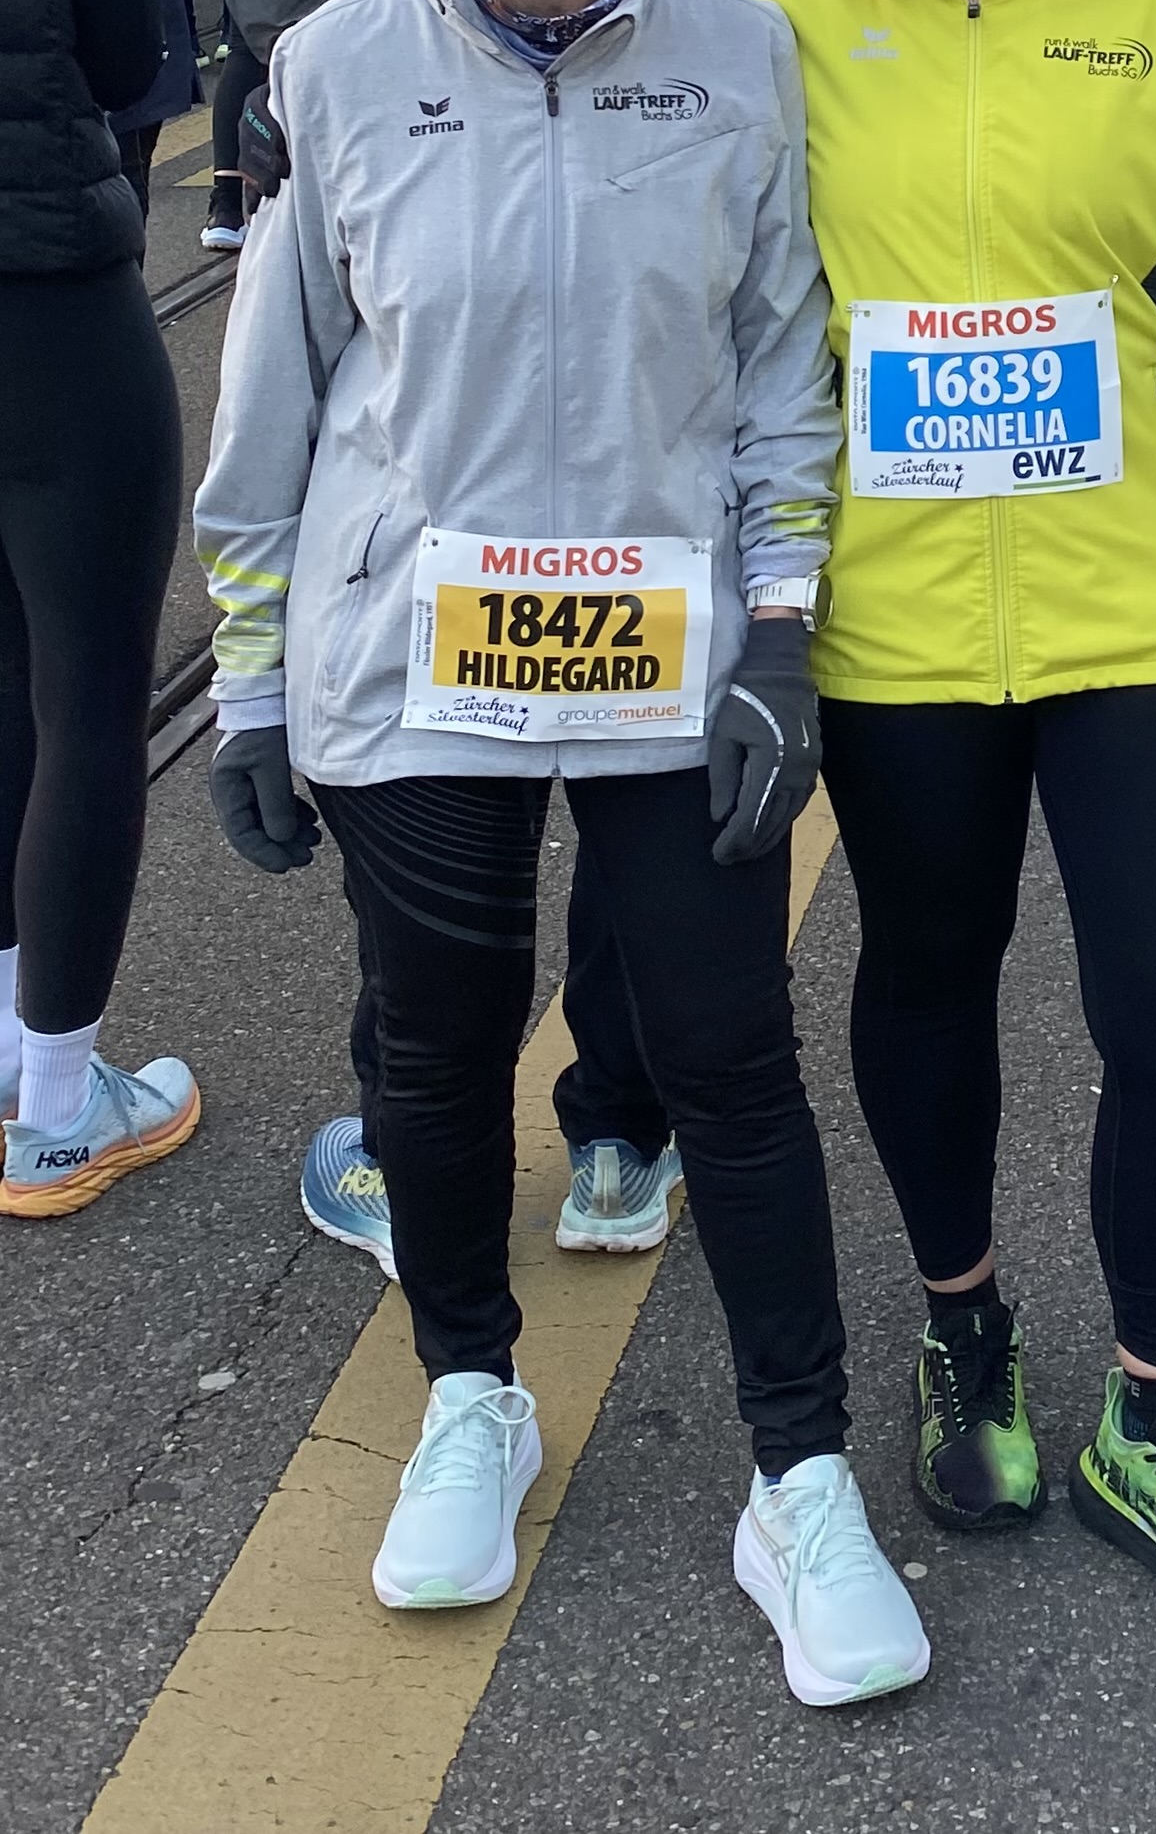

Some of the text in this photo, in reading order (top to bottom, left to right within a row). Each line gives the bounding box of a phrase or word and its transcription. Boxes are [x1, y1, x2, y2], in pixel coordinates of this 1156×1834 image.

[1044, 38, 1061, 46] run
[1072, 38, 1098, 50] walk
[1043, 46, 1136, 66] LAUF-TREFF
[1087, 63, 1138, 80] Buchs SG
[592, 86, 611, 95] run
[621, 82, 647, 95] walk
[593, 94, 686, 110] LAUF-TREFF
[641, 108, 693, 121] Buchs SG
[408, 119, 465, 137] erima
[908, 304, 1057, 339] MIGROS
[907, 349, 1063, 407] 16839
[905, 407, 1068, 450] CORNELIA
[890, 457, 951, 473] Zürcher
[1012, 445, 1086, 480] ewz
[871, 472, 964, 493] Silvesterlauf
[481, 544, 643, 577] MIGROS
[479, 592, 645, 648] 18472
[457, 649, 661, 693] HILDEGARD
[453, 695, 515, 714] Zürcher
[557, 703, 682, 725] groupemutuel
[427, 710, 530, 735] Silvesterlauf
[35, 1145, 90, 1169] HOKA
[336, 1165, 387, 1197] HOK
